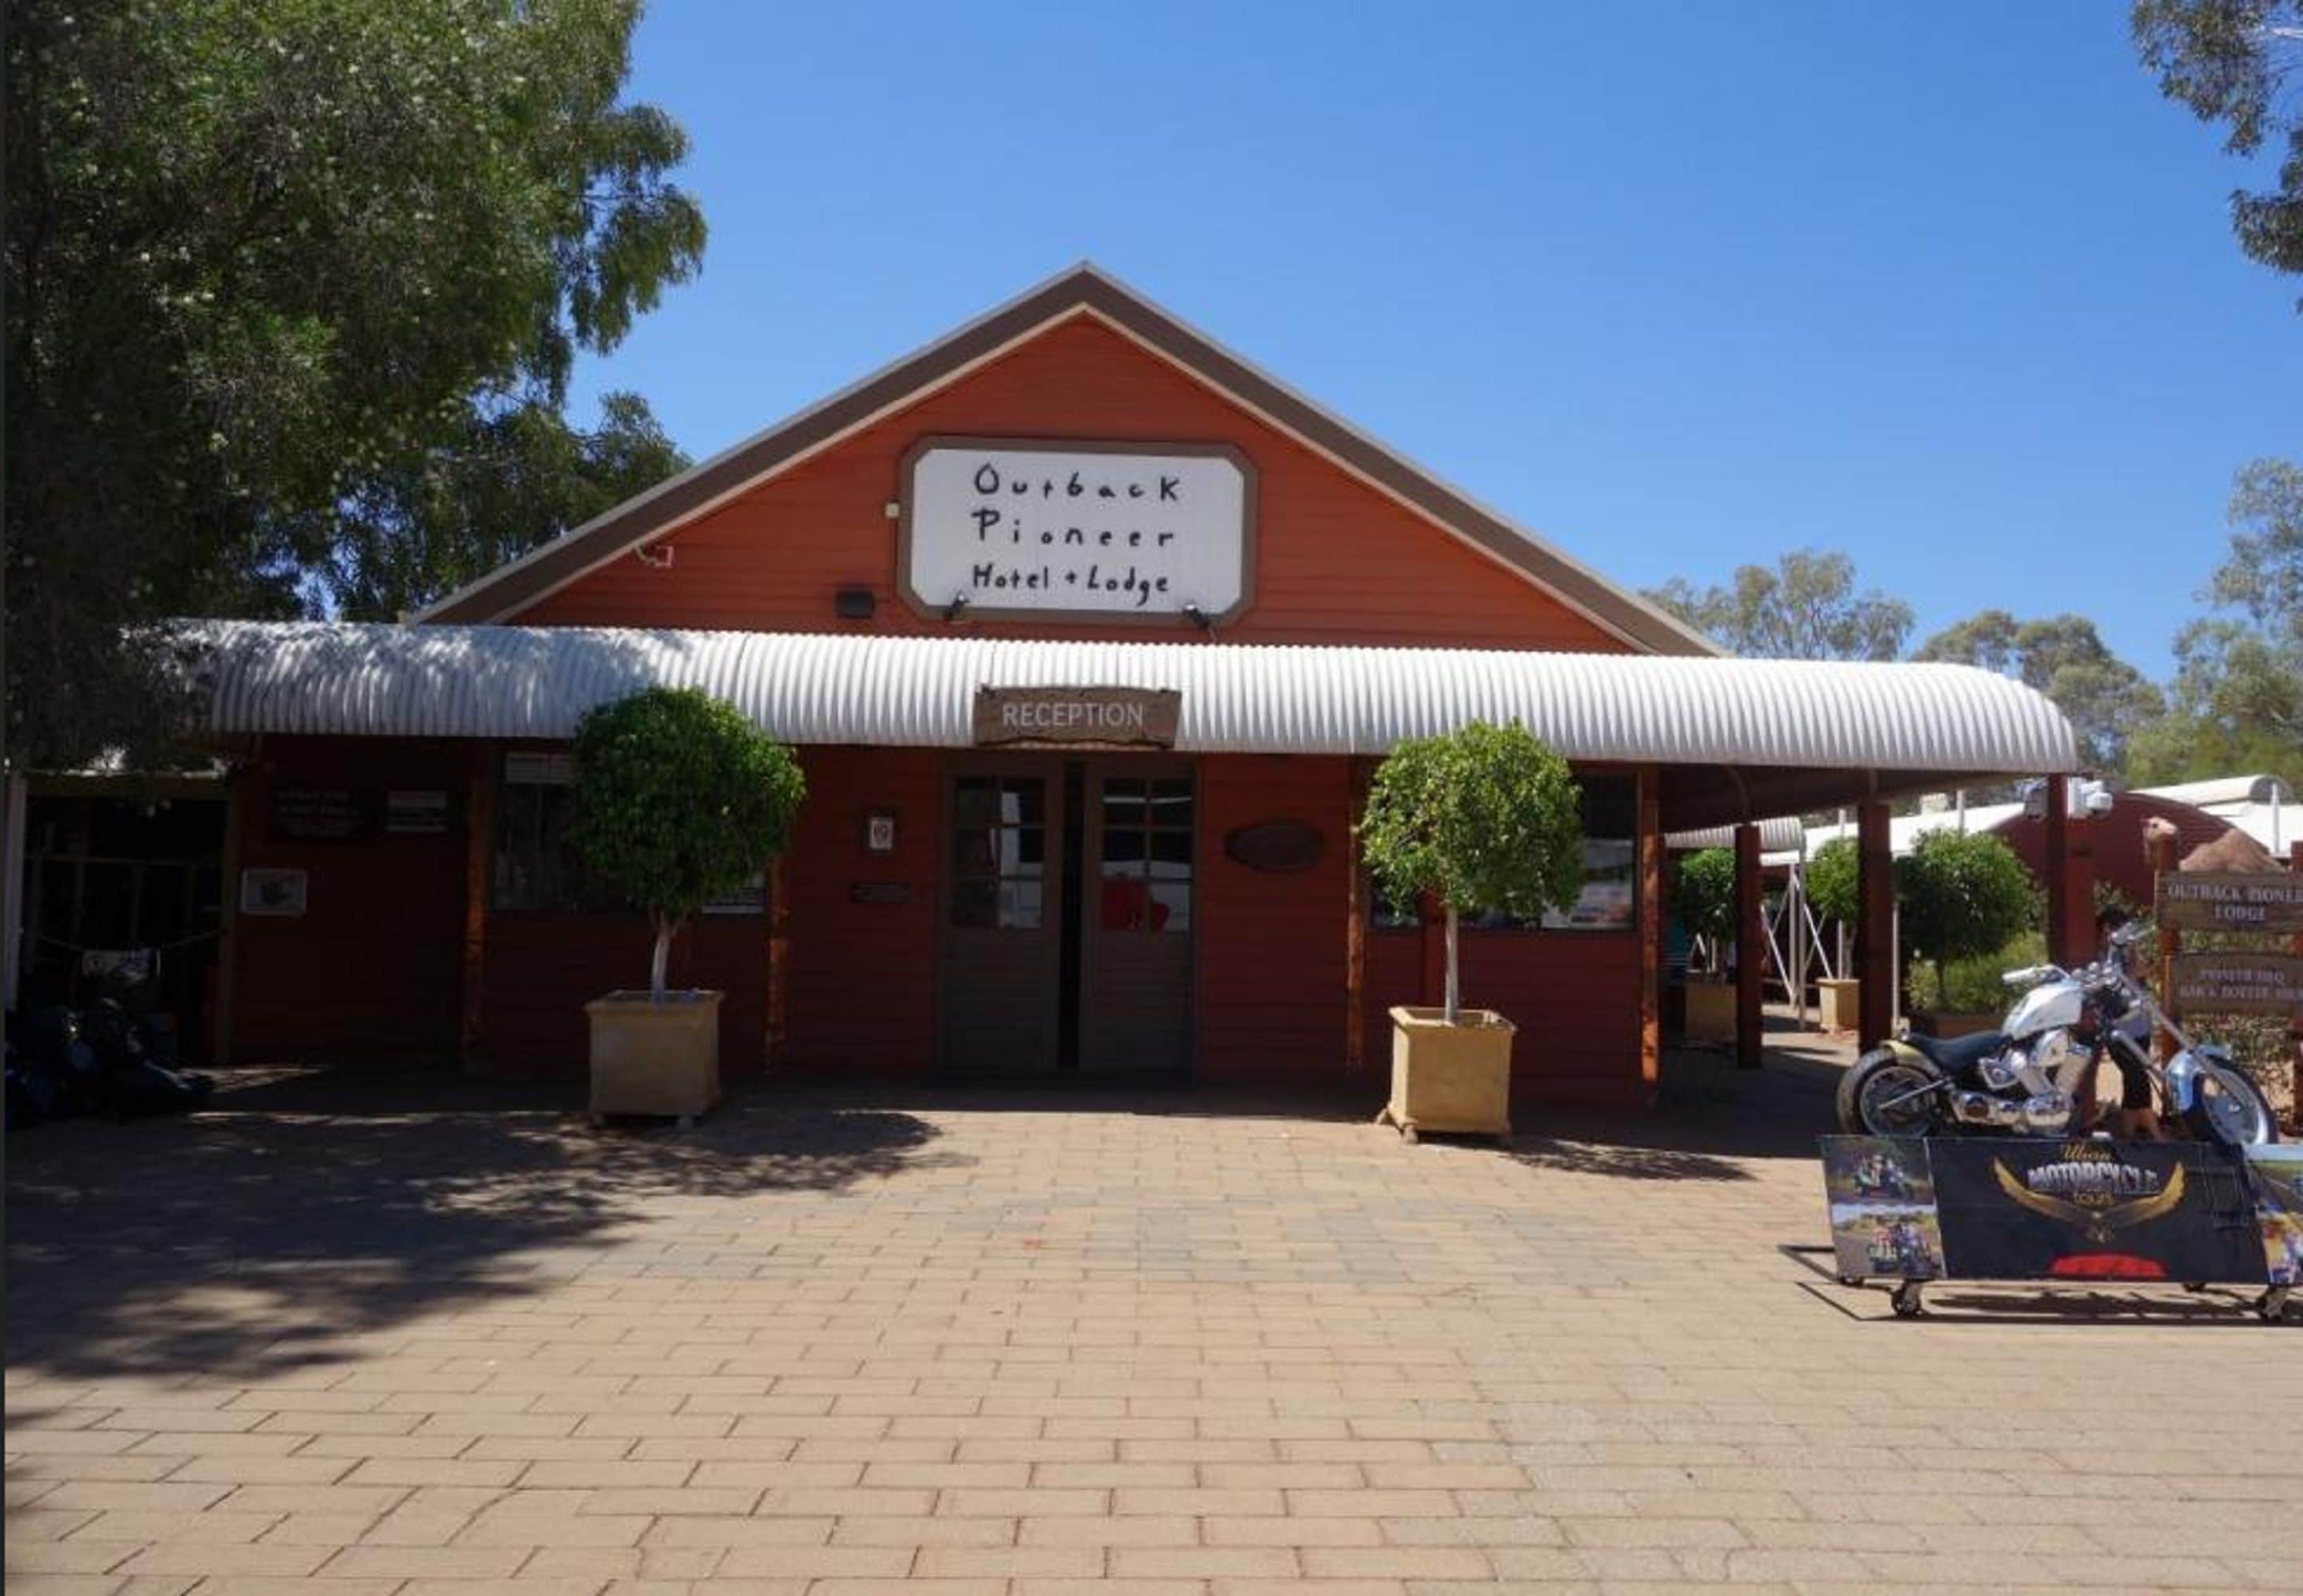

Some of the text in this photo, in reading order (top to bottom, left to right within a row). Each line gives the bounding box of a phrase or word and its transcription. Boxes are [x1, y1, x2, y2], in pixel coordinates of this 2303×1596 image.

[974, 462, 1180, 501] Outback
[971, 508, 1175, 547] Pioneer
[972, 563, 1048, 589] Hotel
[1087, 565, 1169, 606] Lodge
[1002, 703, 1144, 728] RECEPTION
[2167, 883, 2242, 901] OUTBACK
[2213, 905, 2266, 921] LODGE
[2027, 1161, 2159, 1194] MOTORCYCLE
